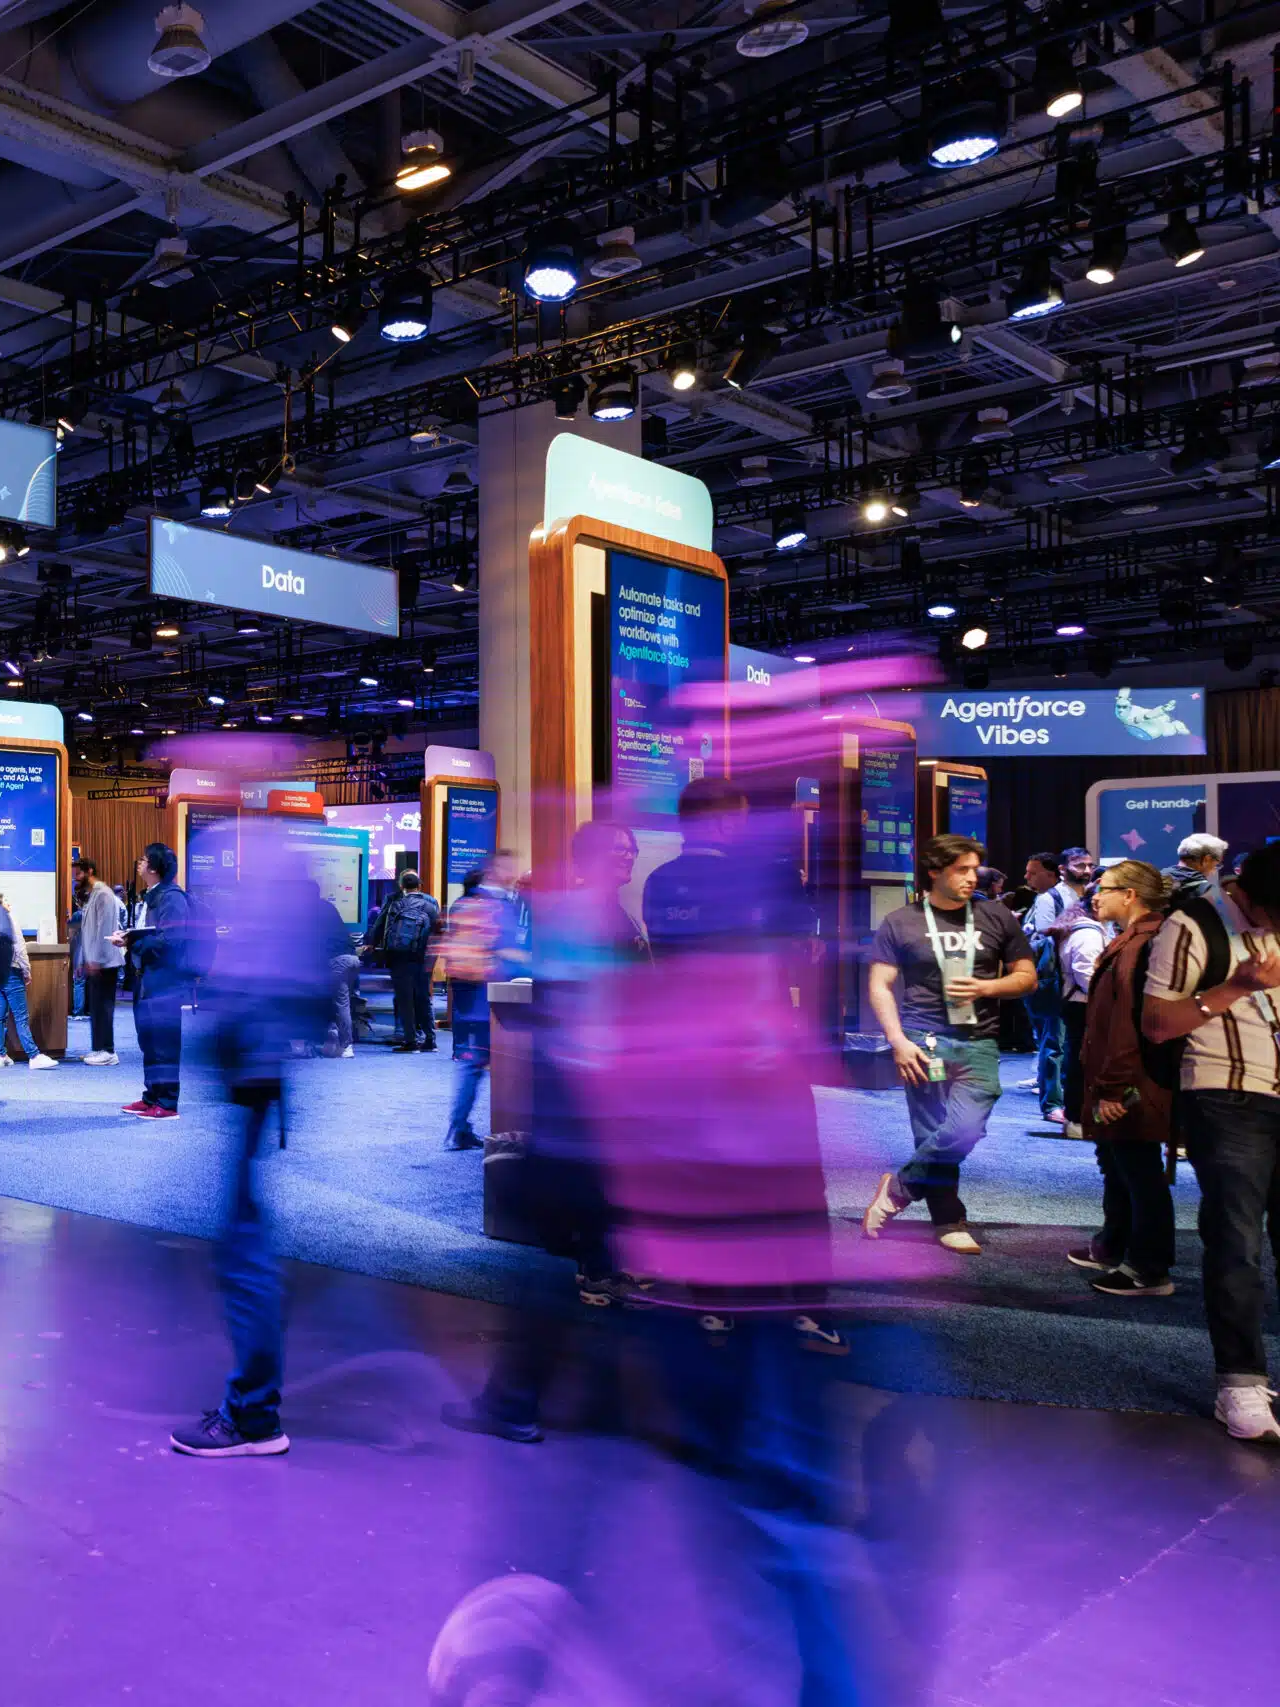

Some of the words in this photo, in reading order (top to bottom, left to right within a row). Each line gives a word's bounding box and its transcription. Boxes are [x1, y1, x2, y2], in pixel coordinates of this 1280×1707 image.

[262, 564, 305, 595] Data
[619, 585, 661, 607] Automate
[663, 594, 684, 613] tasks
[684, 603, 701, 617] and
[619, 605, 656, 625] optimize
[657, 612, 676, 629] deal
[619, 624, 661, 644] workflows
[662, 633, 679, 648] with
[619, 643, 666, 664] Agentforce
[667, 649, 689, 668] Sales
[747, 665, 770, 686] Data
[940, 696, 1086, 722] Agentforce
[617, 727, 635, 738] Scale
[636, 730, 660, 741] revenue
[976, 725, 1049, 744] Vibes
[617, 739, 651, 751] Agentforce
[3, 773, 15, 781] and
[16, 774, 29, 782] A2A
[30, 775, 42, 783] with
[6, 765, 27, 774] agents,
[6, 782, 24, 791] Agent
[1126, 800, 1148, 809] Get
